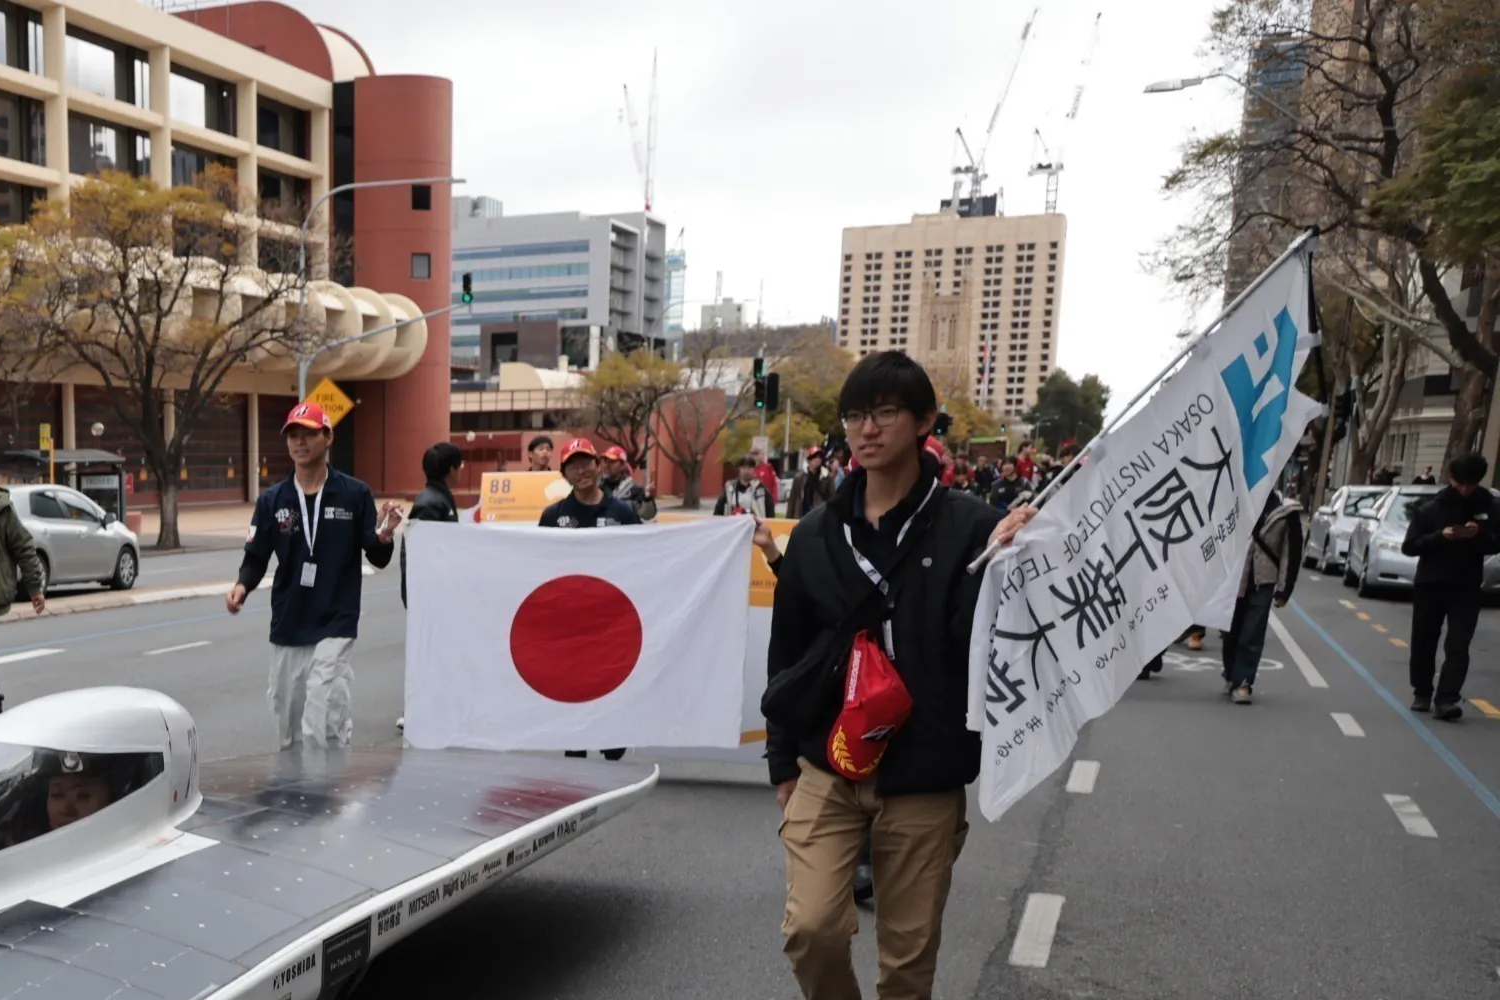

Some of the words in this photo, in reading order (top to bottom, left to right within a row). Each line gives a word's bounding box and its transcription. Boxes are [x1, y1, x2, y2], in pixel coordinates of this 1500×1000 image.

[316, 393, 334, 402] FIRE
[1152, 393, 1213, 455] OSAKA
[490, 479, 510, 493] 88
[1077, 450, 1155, 542] INSTITUTE
[1063, 533, 1081, 563] OF
[408, 888, 440, 916] MITSUBA
[281, 953, 316, 986] YOSHIDA
